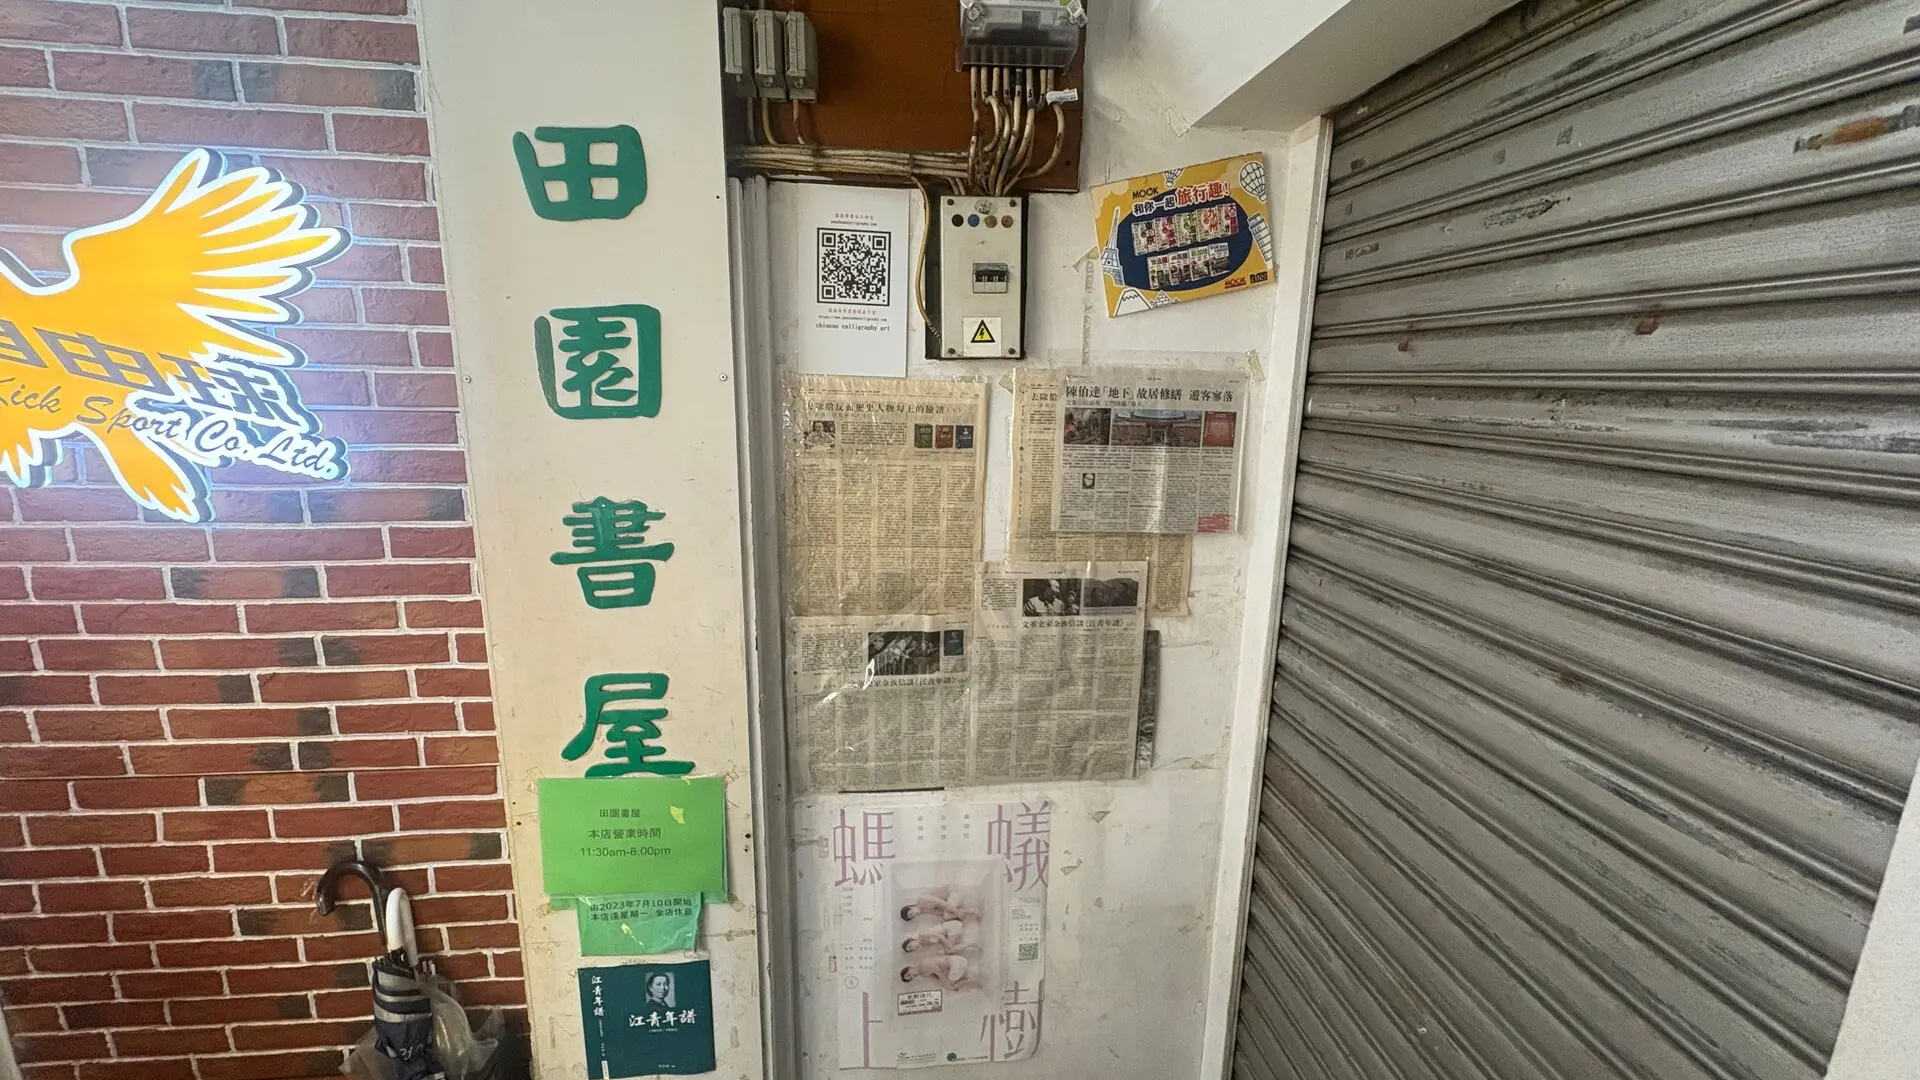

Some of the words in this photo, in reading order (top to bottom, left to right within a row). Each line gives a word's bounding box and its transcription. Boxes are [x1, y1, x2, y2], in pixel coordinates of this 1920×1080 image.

[1132, 187, 1159, 199] MOOK
[815, 321, 839, 329] chinese
[841, 323, 877, 332] calligraphy
[76, 395, 184, 440] Sport
[195, 418, 250, 456] Co.
[257, 432, 333, 473] Ltd.
[512, 123, 697, 779] 田園書屋
[599, 808, 641, 818] 田園書屋
[588, 828, 662, 839] 本店營業時間
[580, 846, 671, 858] 11:30am-8:00pm
[590, 898, 693, 912] 由2023年7月10日開始
[591, 975, 605, 1017] 江青年譜
[629, 1008, 698, 1028] 江青年譜
